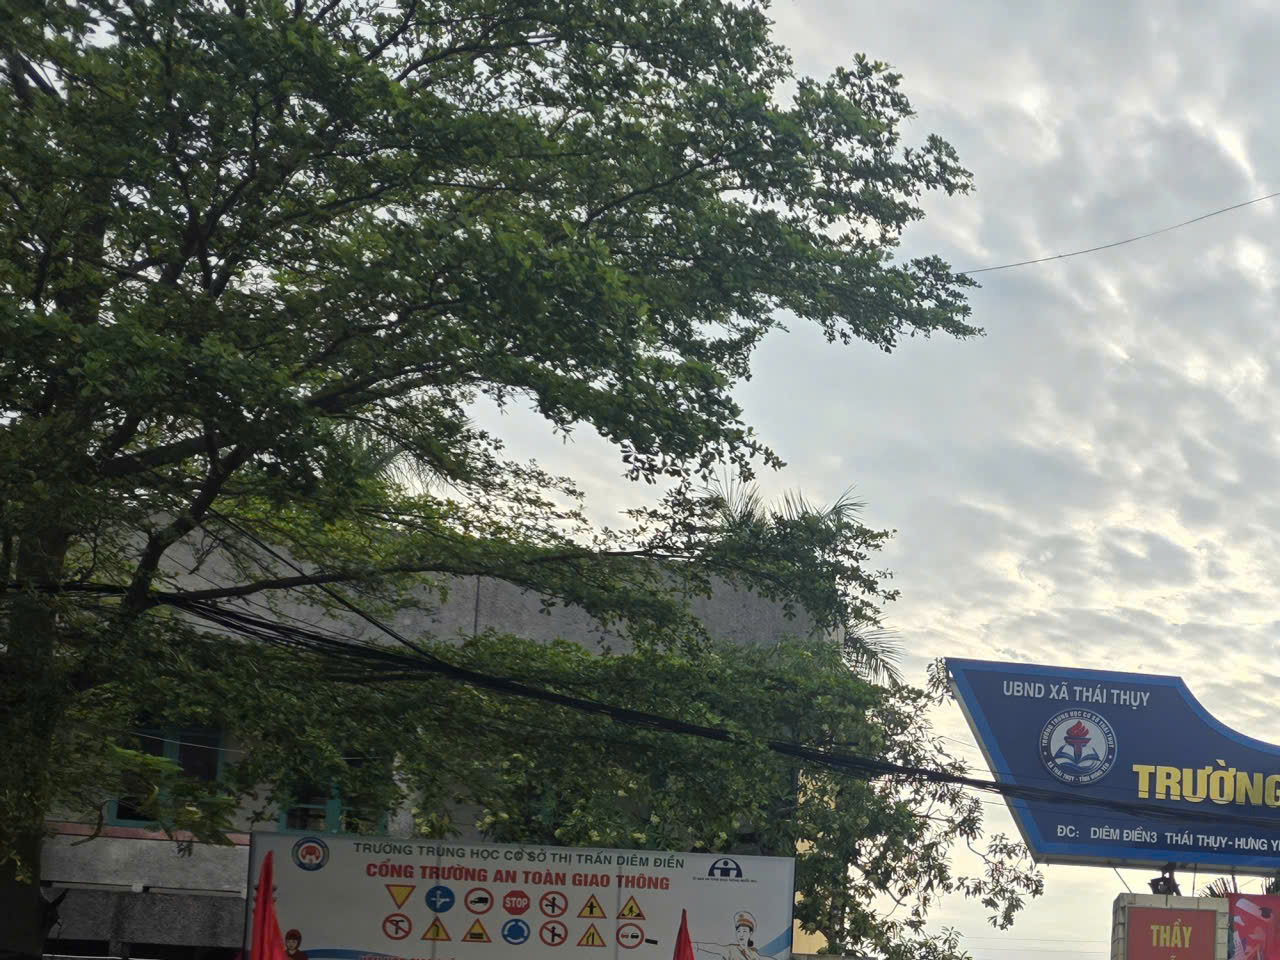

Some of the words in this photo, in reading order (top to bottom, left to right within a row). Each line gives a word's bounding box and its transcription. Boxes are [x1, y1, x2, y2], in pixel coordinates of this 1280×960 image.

[1003, 680, 1045, 698] UBND
[1049, 680, 1069, 701] XÃ
[1073, 684, 1106, 704] THÁI
[1111, 689, 1150, 710] THỤY
[1057, 824, 1080, 838] ĐC:
[1090, 825, 1120, 841] DIÊM
[1165, 830, 1193, 846] THÁI
[353, 842, 413, 856] TRƯỜNG
[418, 845, 466, 858] TRUNG
[470, 849, 500, 861] HỌC
[551, 852, 572, 866] THỊ
[576, 851, 612, 865] TRẤN
[617, 853, 649, 867] DIÊM
[366, 859, 414, 879] CỔNG
[420, 864, 488, 882] TRƯỜNG
[493, 869, 517, 884] AN
[522, 869, 567, 886] TOÀN
[572, 872, 610, 887] GIAO
[616, 872, 670, 890] THÔNG
[505, 896, 529, 909] STOP
[1151, 918, 1192, 948] THẦY
